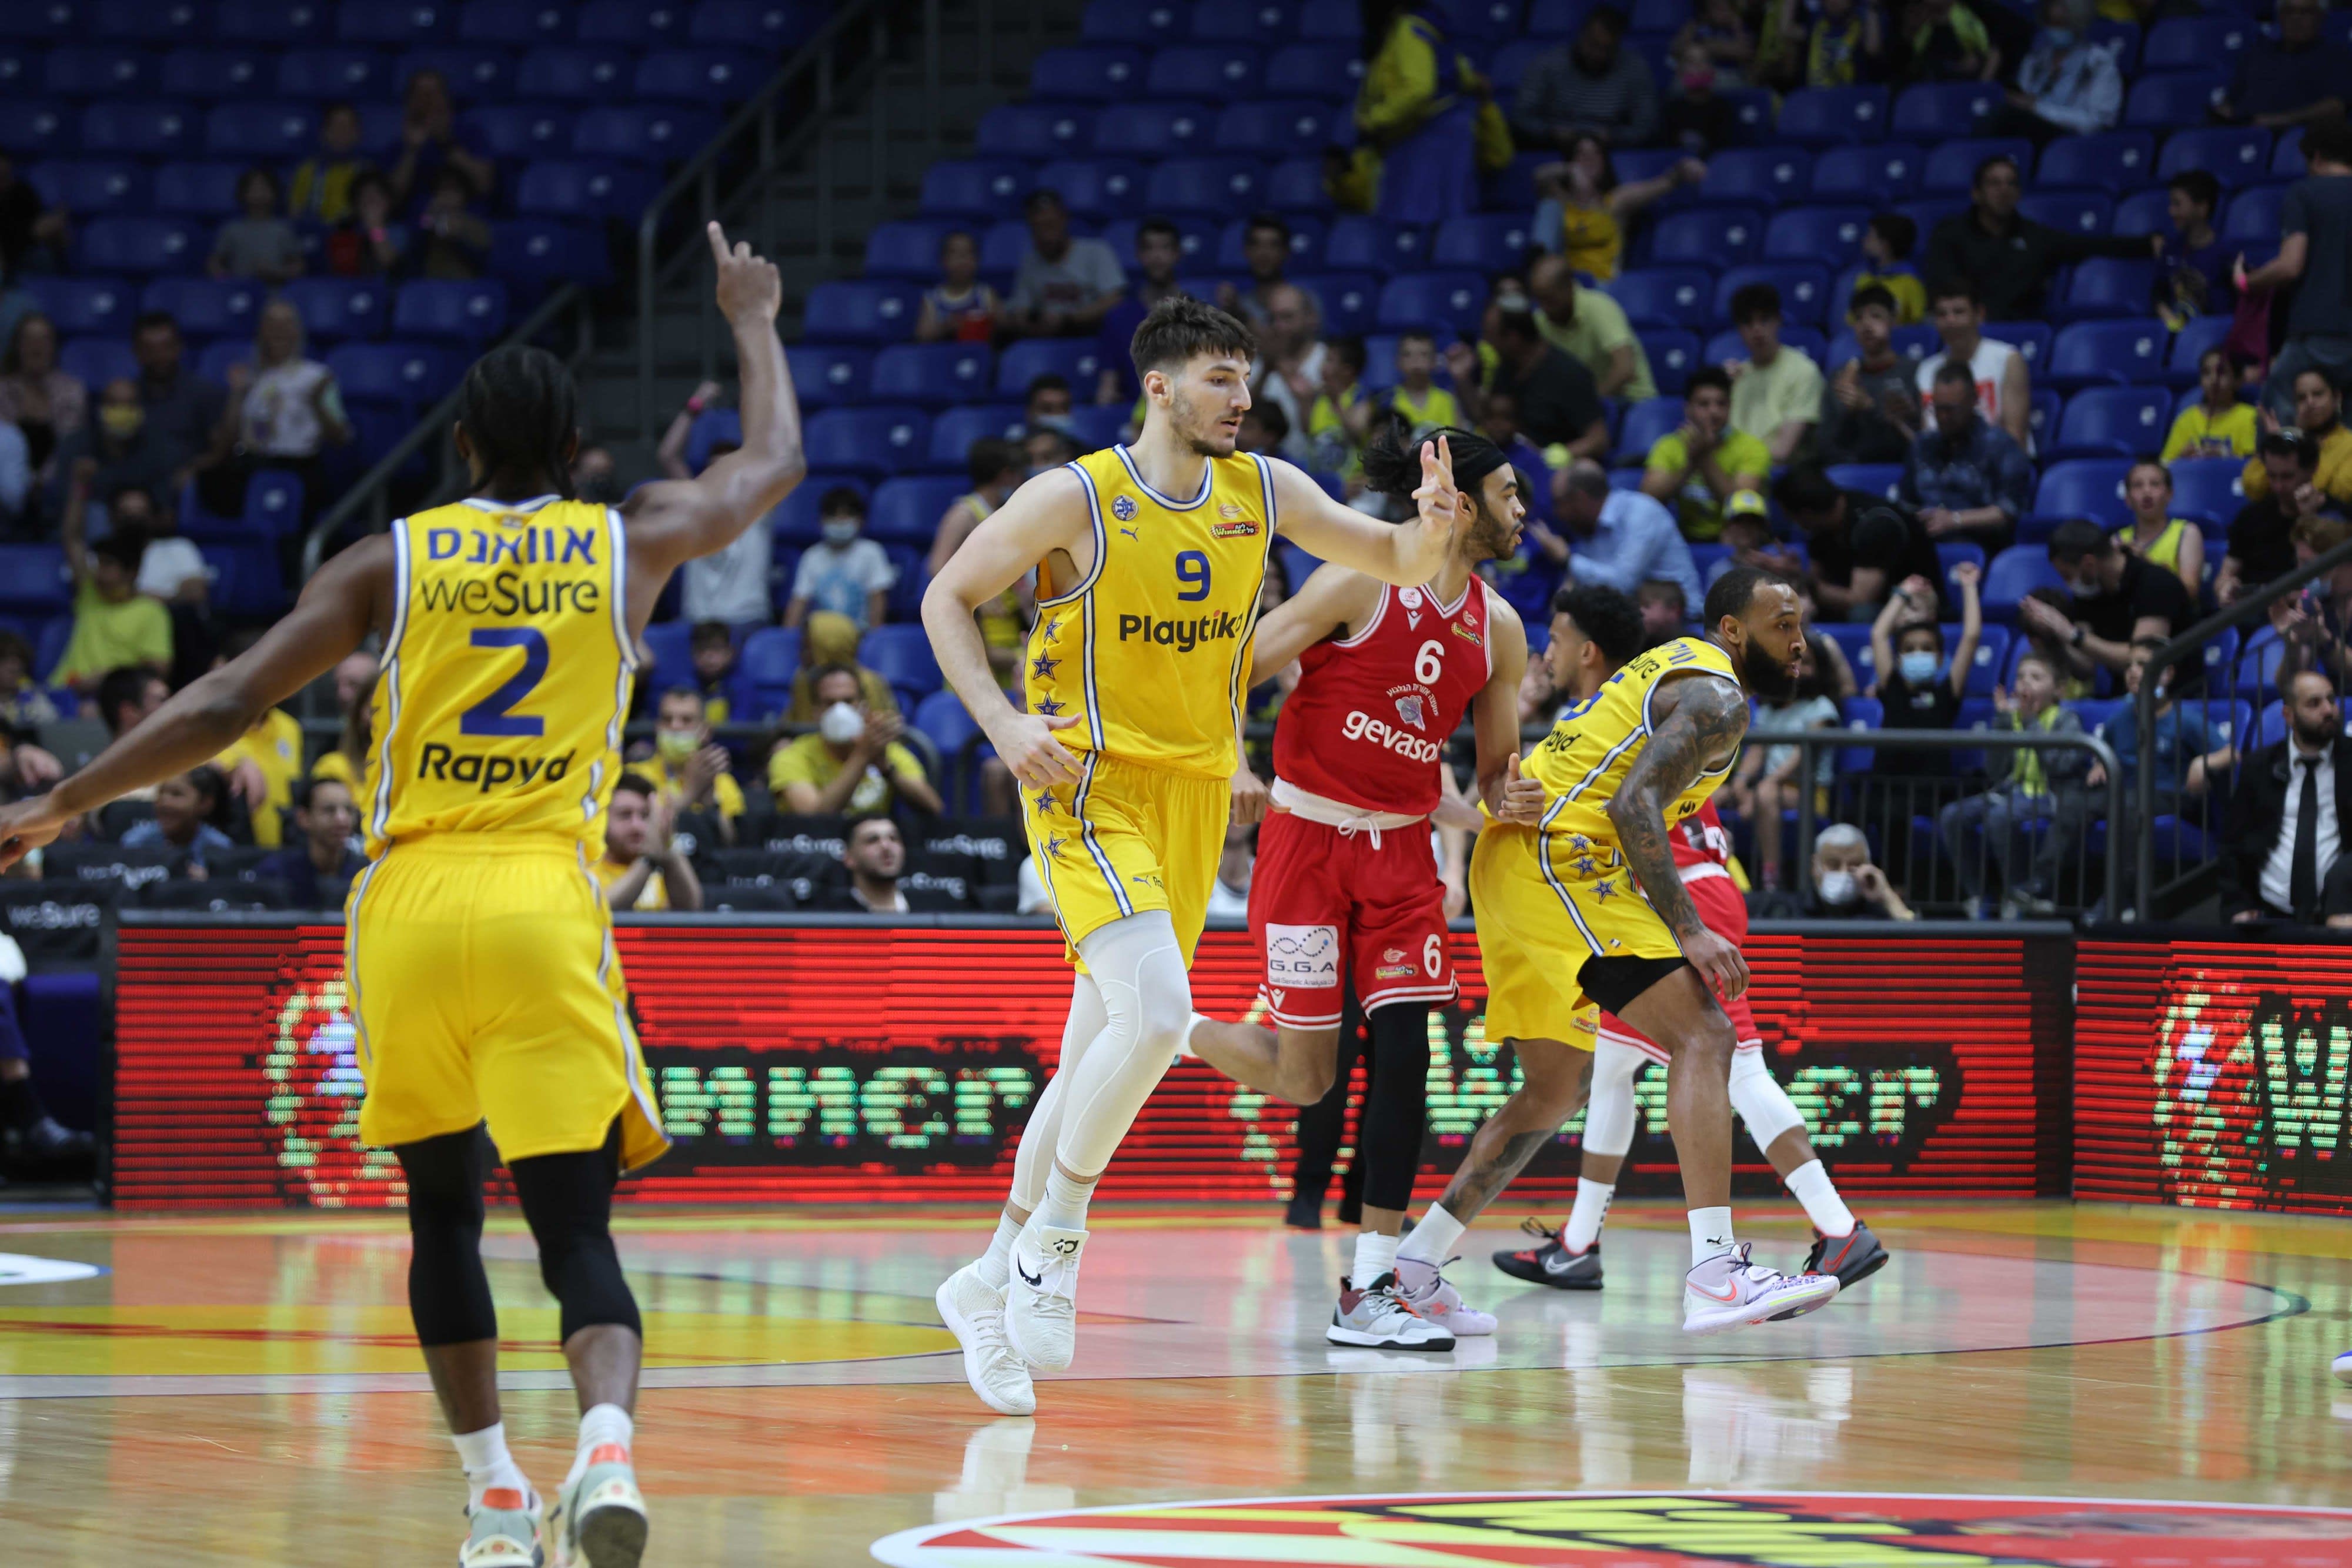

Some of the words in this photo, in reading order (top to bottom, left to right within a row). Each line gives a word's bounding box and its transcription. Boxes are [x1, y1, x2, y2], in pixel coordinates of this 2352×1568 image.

[427, 527, 598, 565] אוואנס
[1215, 527, 1246, 536] Winner
[421, 571, 599, 617] weSure
[1175, 550, 1211, 601] 9
[459, 626, 549, 737] 2
[1414, 639, 1445, 685] 6
[417, 743, 577, 793] Rapyd
[1270, 959, 1335, 973] G.G.A
[1423, 933, 1442, 979] 6
